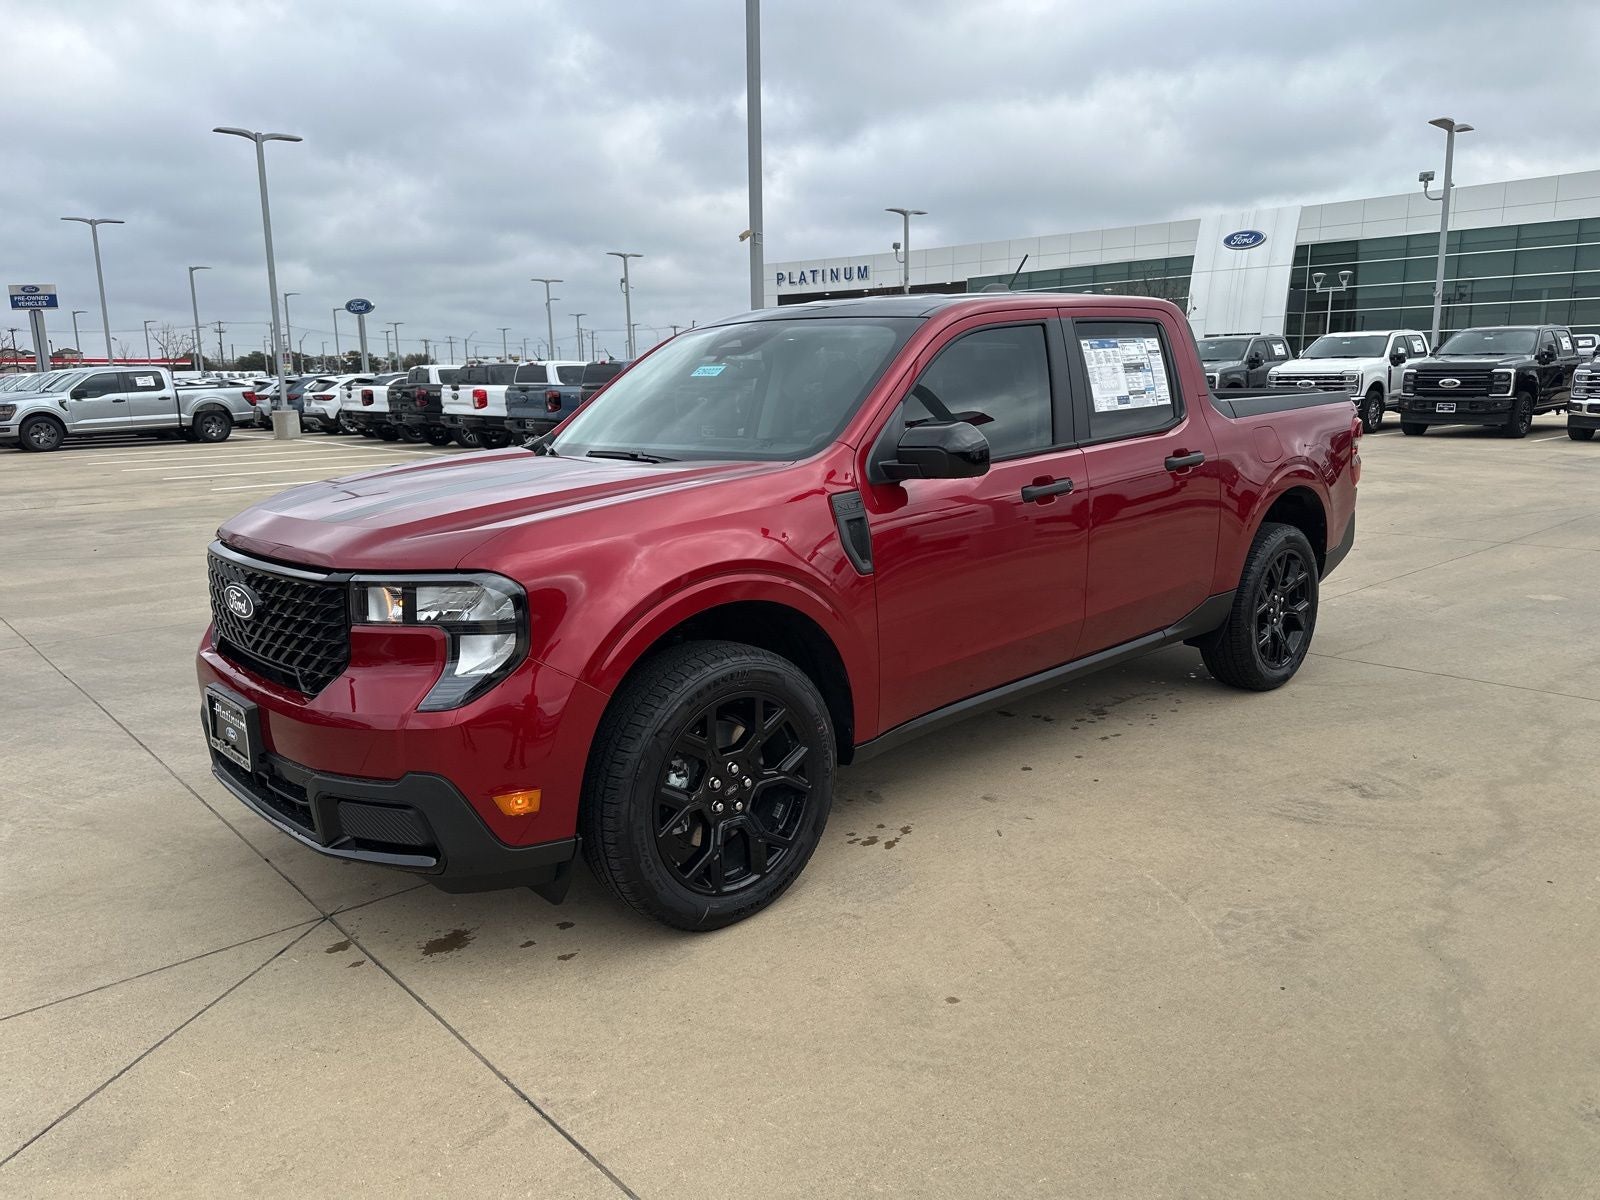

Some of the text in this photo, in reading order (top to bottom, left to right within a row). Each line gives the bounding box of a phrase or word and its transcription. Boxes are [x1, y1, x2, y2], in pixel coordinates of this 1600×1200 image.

[1231, 233, 1256, 245] Ford
[776, 265, 868, 286] PLATINUM
[229, 589, 248, 614] Ford
[213, 701, 247, 733] Platinum
